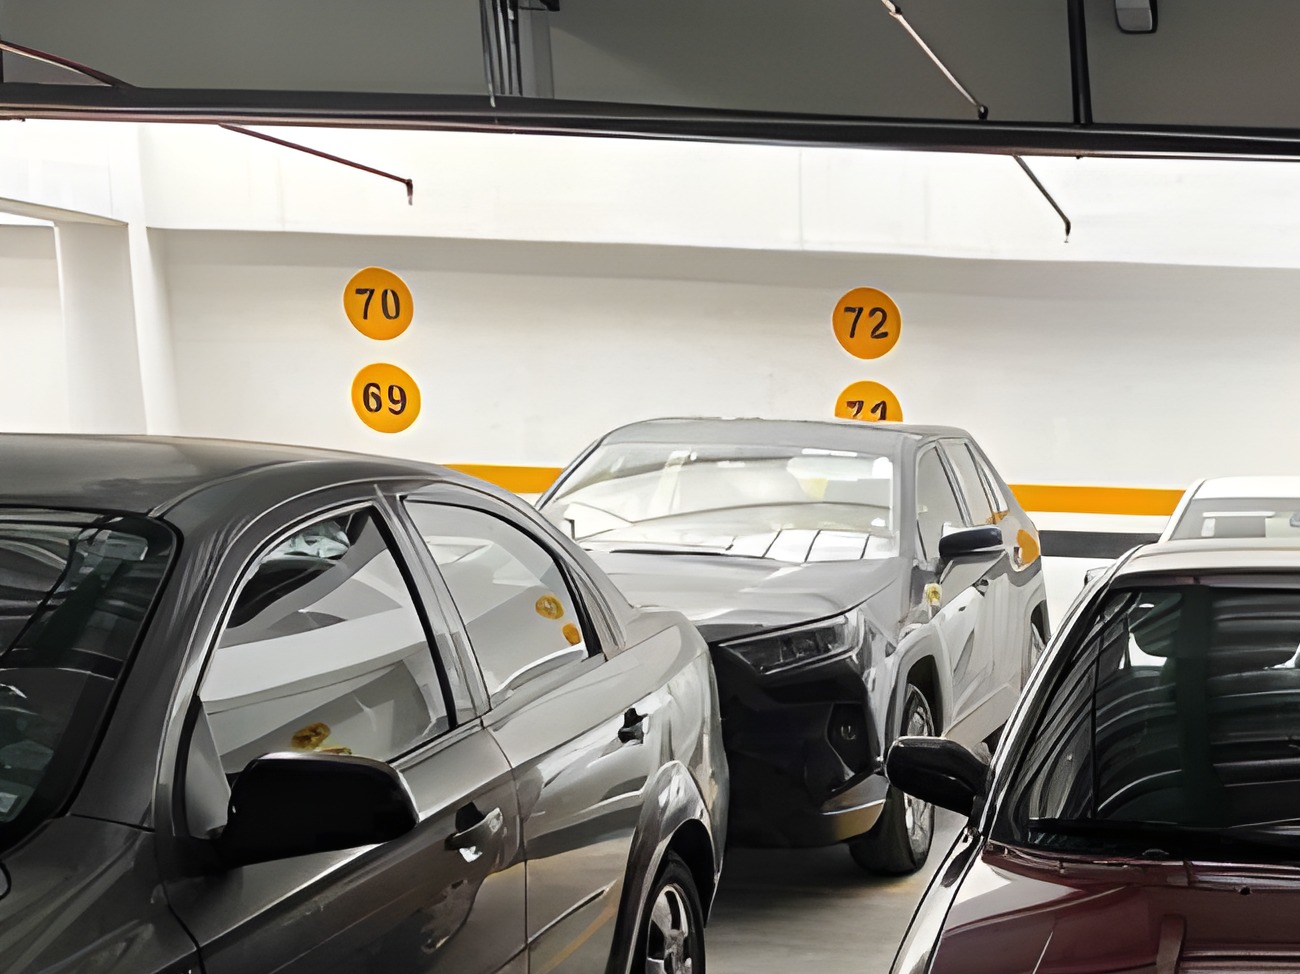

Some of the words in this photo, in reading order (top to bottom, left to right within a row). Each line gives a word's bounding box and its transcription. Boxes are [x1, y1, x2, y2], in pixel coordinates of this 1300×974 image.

[355, 287, 401, 320] 70
[843, 306, 888, 339] 72
[363, 382, 407, 416] 69
